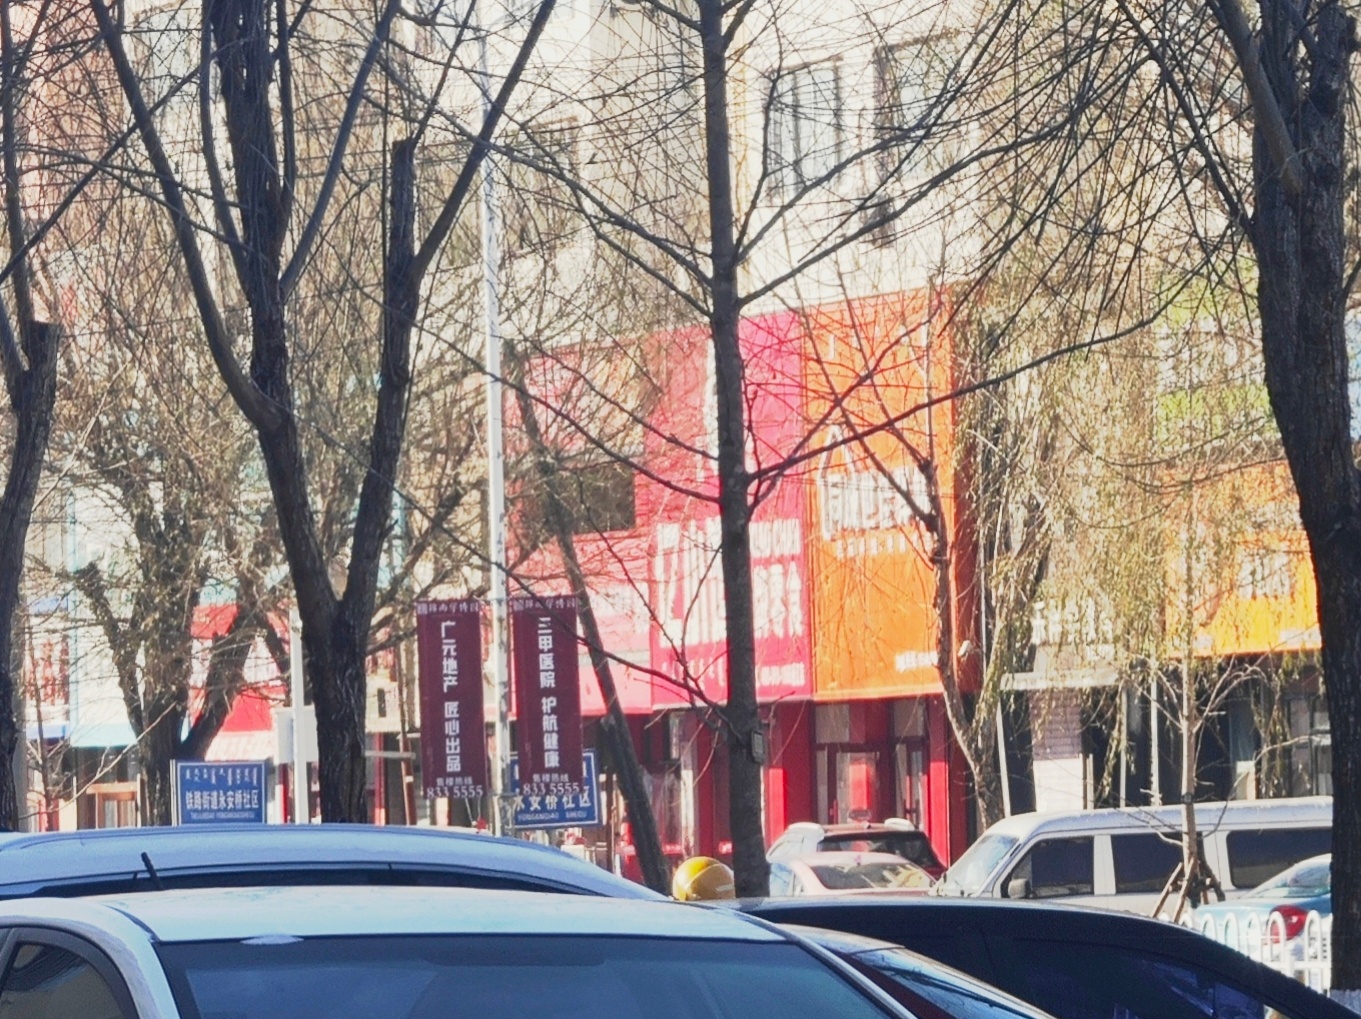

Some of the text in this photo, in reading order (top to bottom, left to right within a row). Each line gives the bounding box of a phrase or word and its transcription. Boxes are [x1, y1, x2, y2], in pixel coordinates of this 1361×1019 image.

[440, 620, 462, 772] 广元地产 匠心出品
[537, 616, 560, 769] 三甲医院 护航健康
[426, 784, 484, 799] 833 5555
[523, 781, 580, 795] 833 5555
